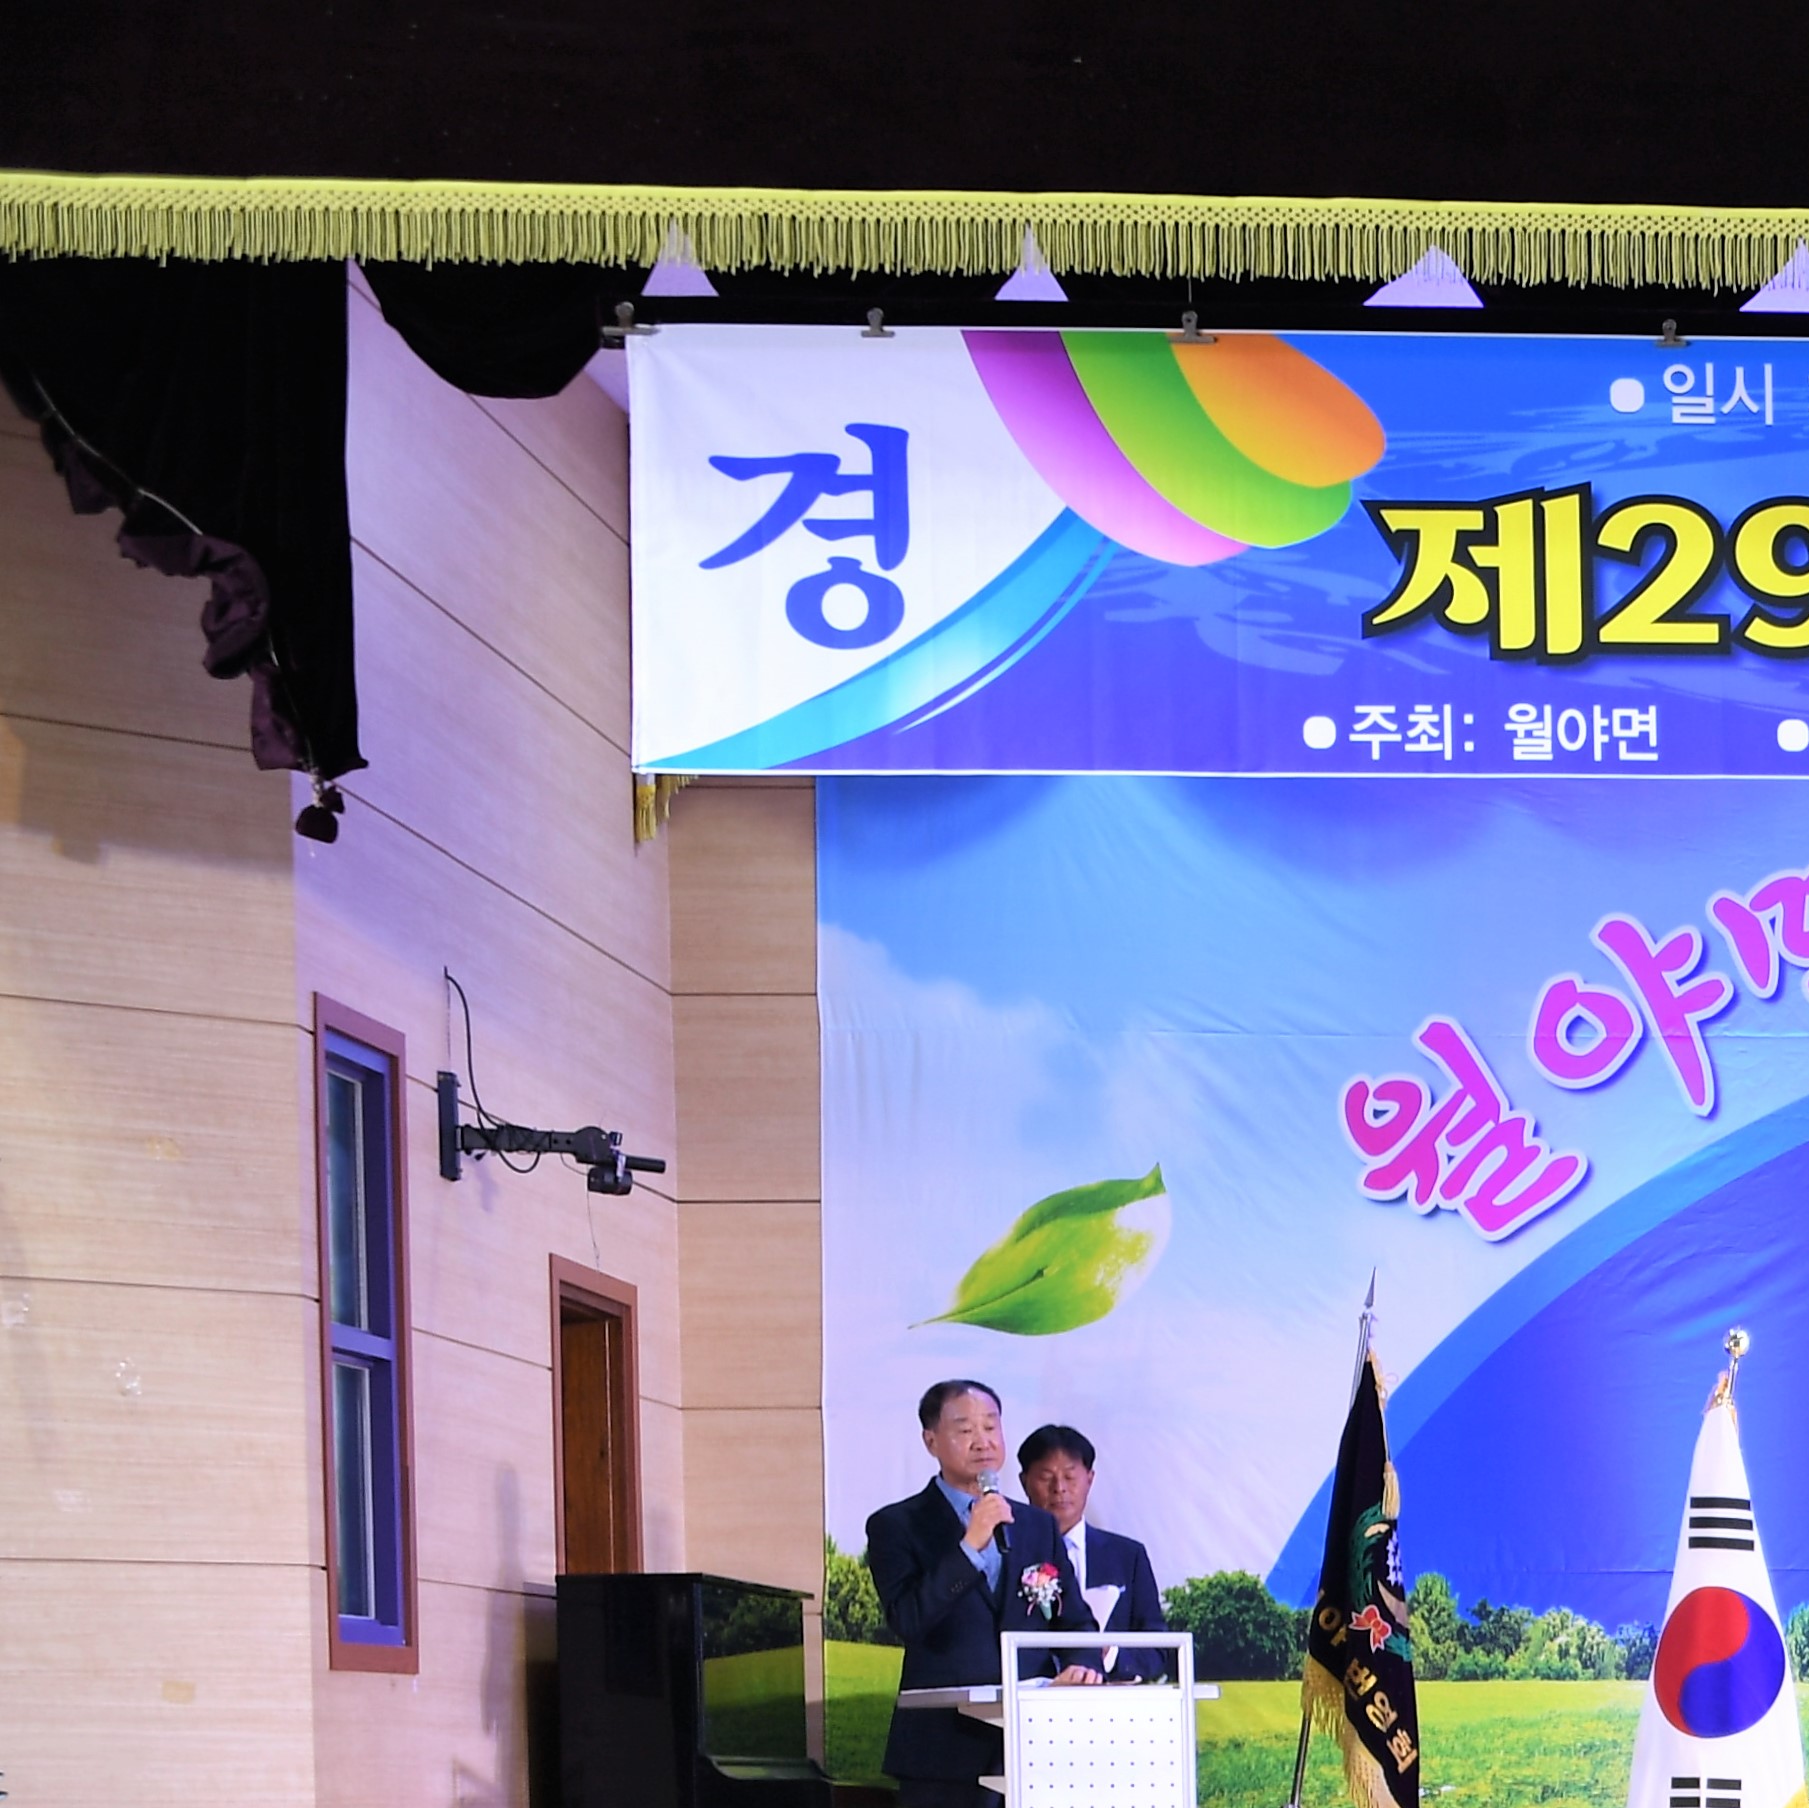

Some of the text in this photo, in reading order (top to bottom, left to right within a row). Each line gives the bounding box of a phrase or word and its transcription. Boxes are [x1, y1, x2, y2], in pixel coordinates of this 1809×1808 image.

[1662, 362, 1774, 426] 일시
[698, 422, 910, 650] 경
[1503, 702, 1660, 762] 월야면
